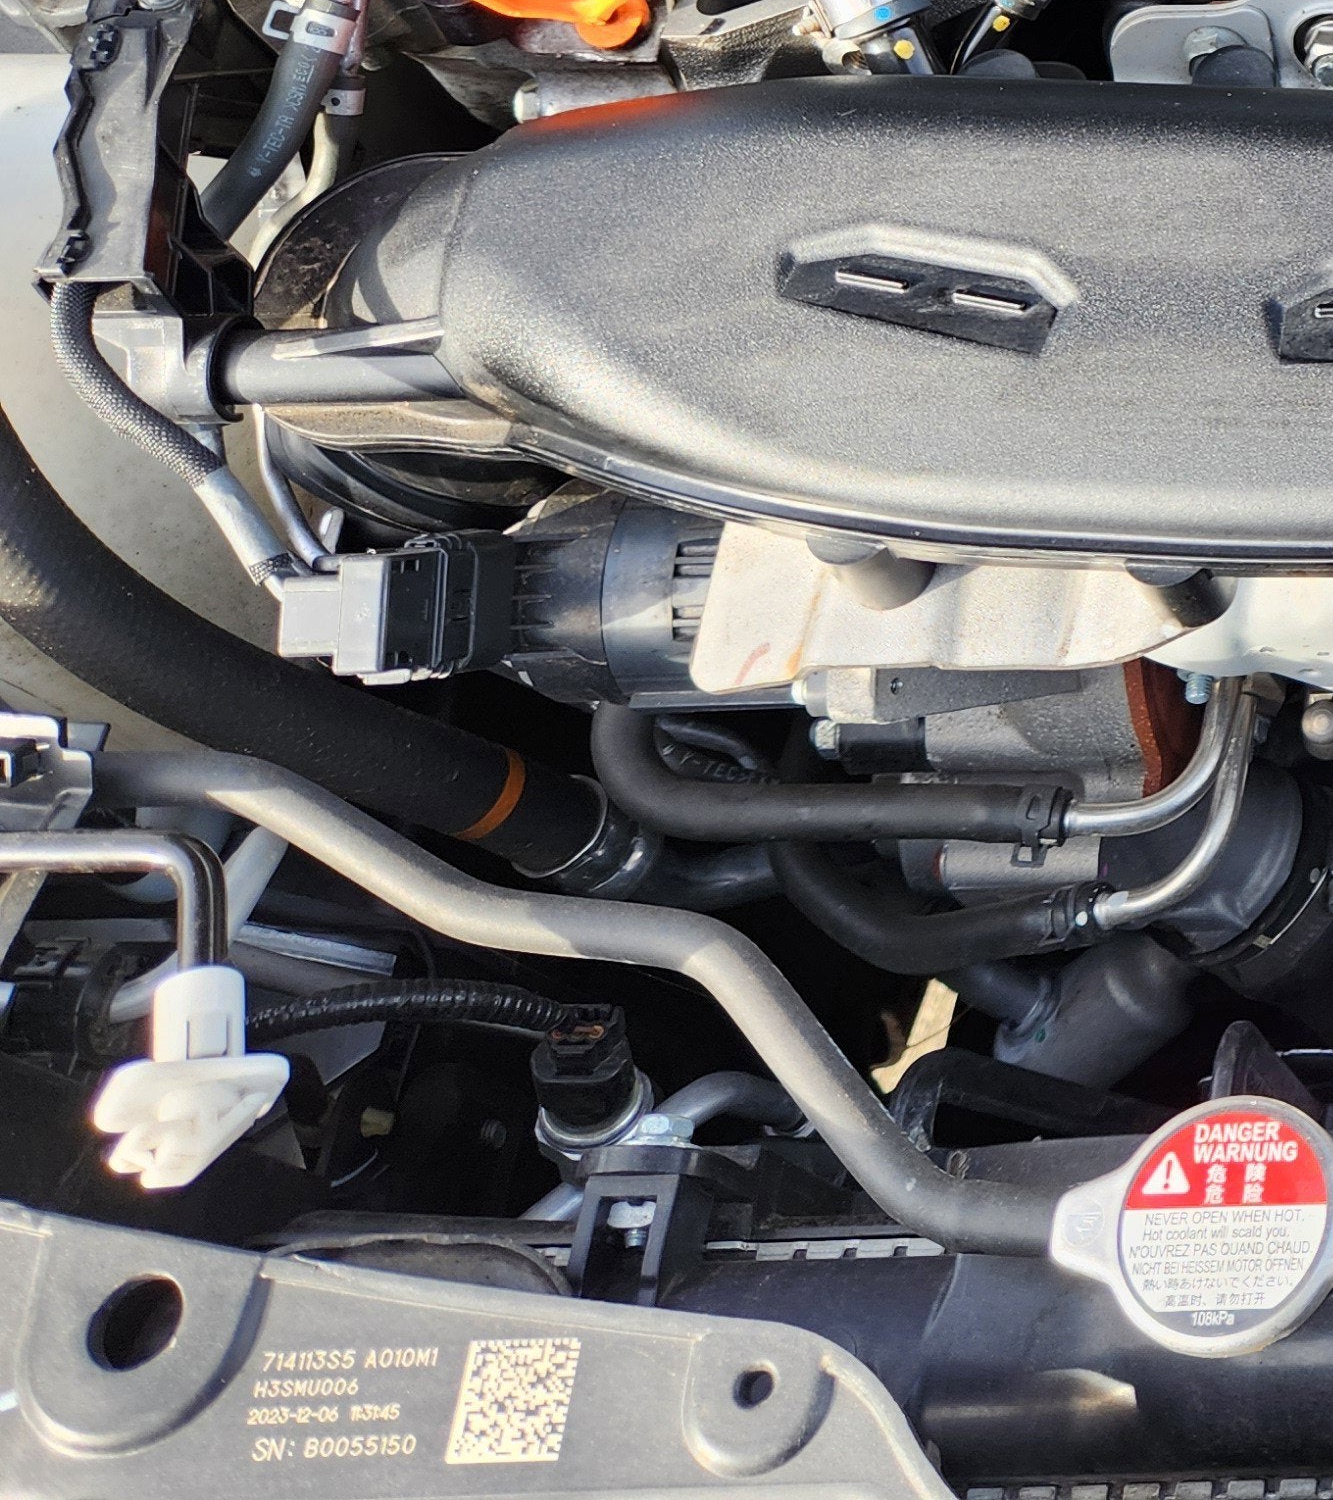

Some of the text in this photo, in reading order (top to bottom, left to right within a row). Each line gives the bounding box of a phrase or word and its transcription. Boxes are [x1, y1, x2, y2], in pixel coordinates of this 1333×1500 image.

[1194, 1122, 1281, 1144] DANGER
[1194, 1141, 1299, 1163] WARNUNG
[1145, 1208, 1305, 1226] NEVER OPEN WHEN HOT.
[1142, 1224, 1290, 1241] Hot coolant will scald you.
[1193, 1241, 1222, 1256] PAS
[1132, 1260, 1161, 1276] NICHT
[1162, 1260, 1180, 1275] BEI
[1181, 1259, 1225, 1275] HEISSEM
[1226, 1258, 1263, 1273] MOTOR
[1191, 1310, 1235, 1327] 108kPa
[262, 1347, 439, 1372] 714113S5 A010M1
[254, 1379, 359, 1398] H3SMU006
[246, 1403, 400, 1426] 2023-12-06 11:31:45
[251, 1435, 417, 1462] SN: B0055150
